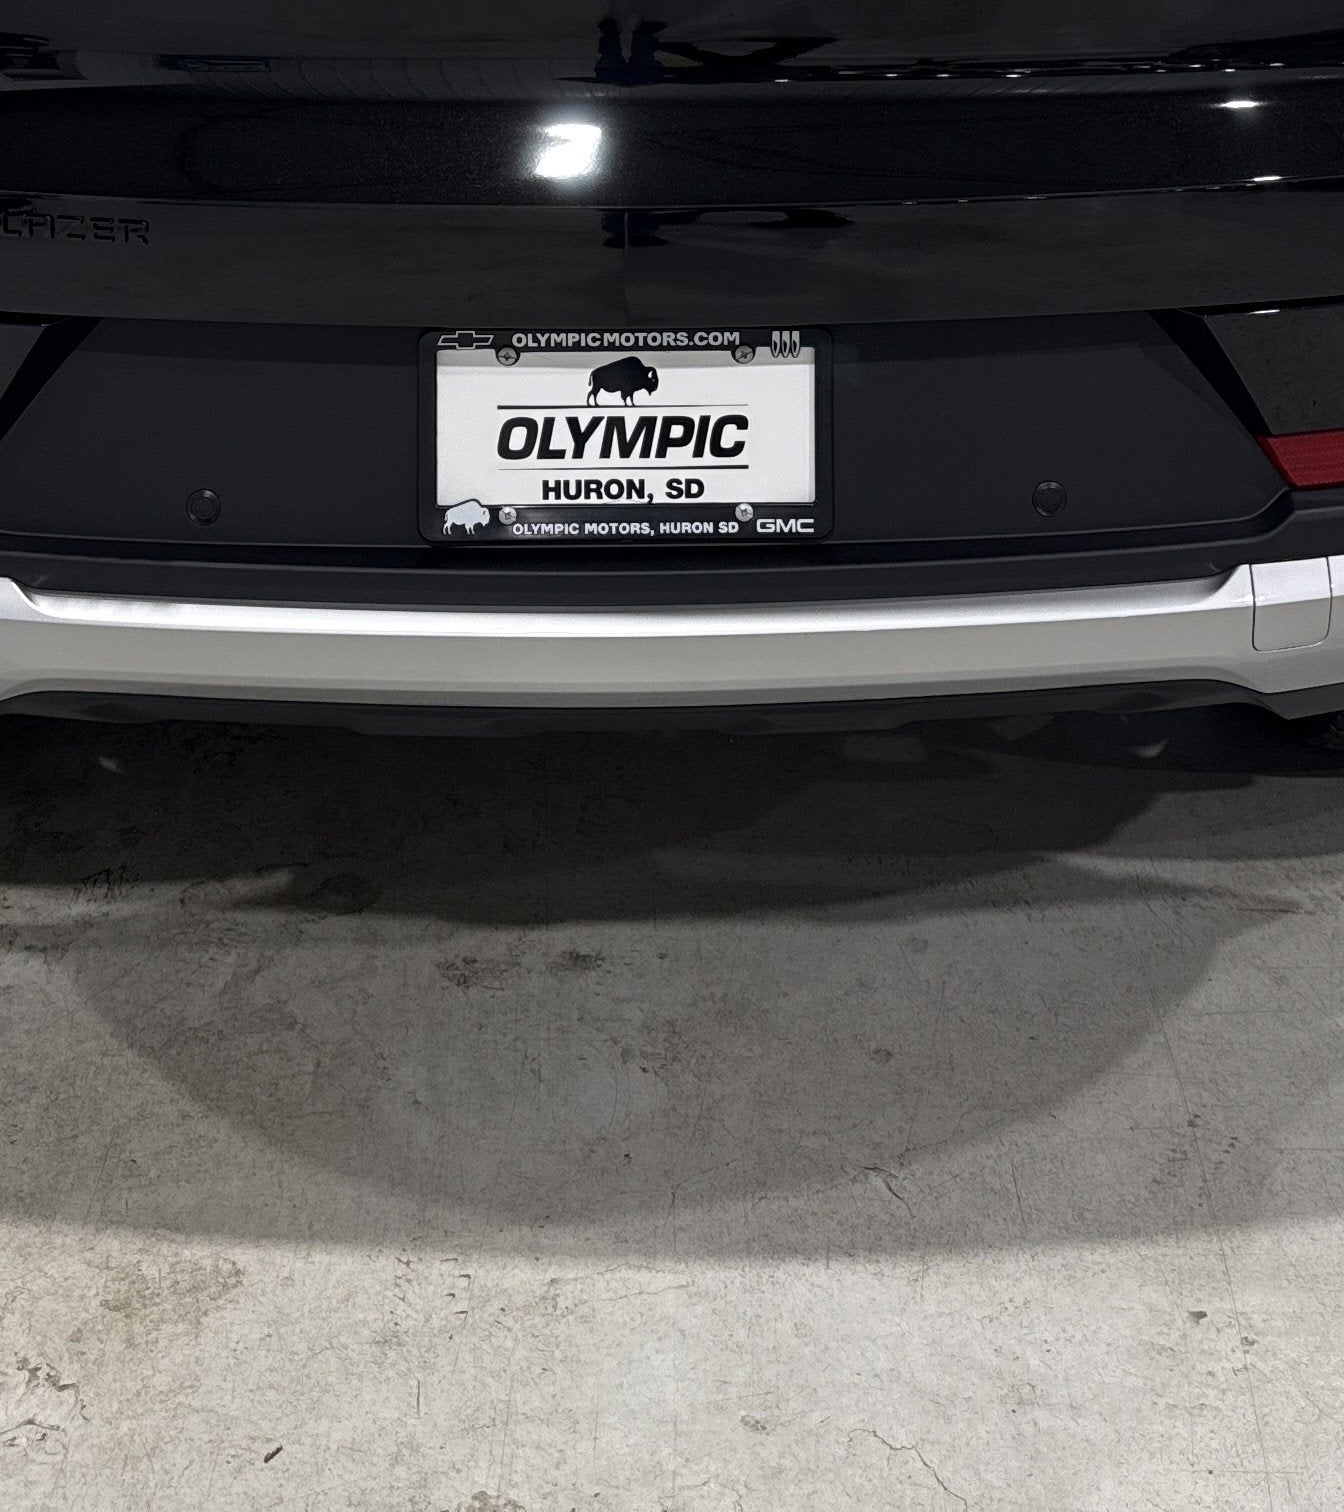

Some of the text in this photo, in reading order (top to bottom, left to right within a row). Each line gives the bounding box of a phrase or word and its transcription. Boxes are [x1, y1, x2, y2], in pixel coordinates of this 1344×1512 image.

[512, 331, 740, 348] OLYMPICMOTORS.COM
[497, 414, 749, 460] OLYMPIC
[542, 478, 705, 503] HURON, SD
[512, 521, 739, 537] OLYMPIC MOTORS, HURON SD
[756, 518, 815, 534] GMC
